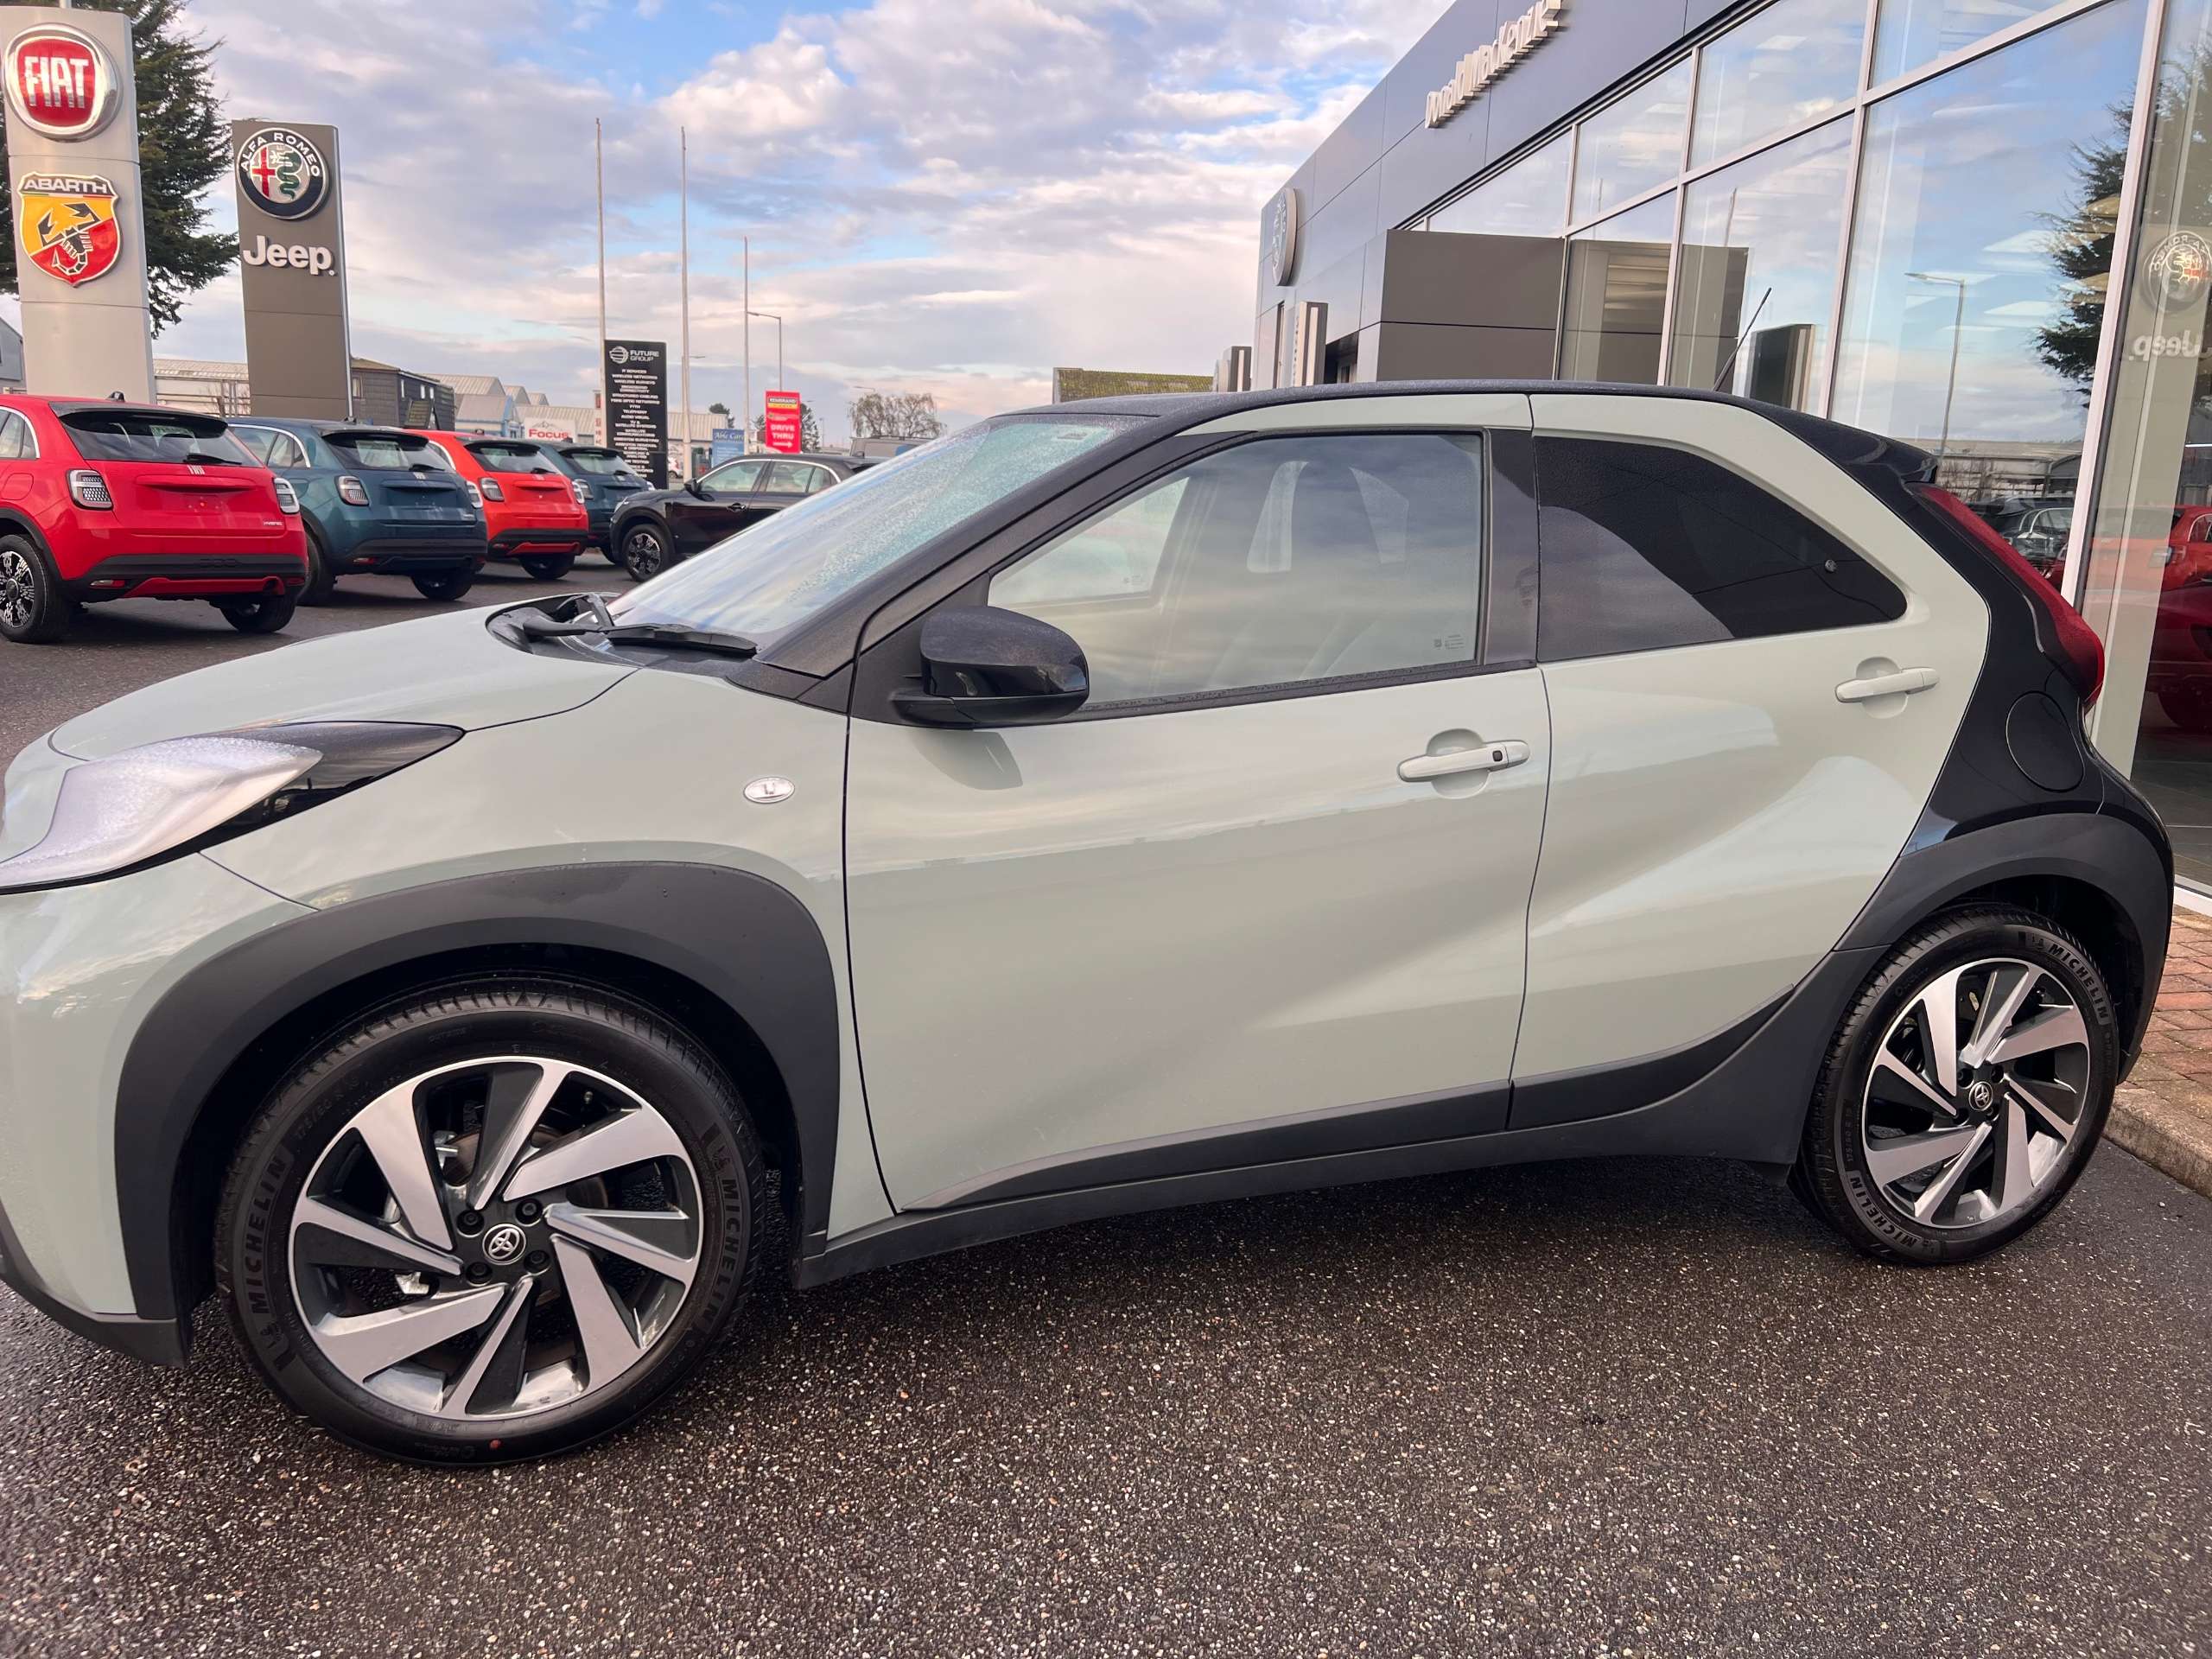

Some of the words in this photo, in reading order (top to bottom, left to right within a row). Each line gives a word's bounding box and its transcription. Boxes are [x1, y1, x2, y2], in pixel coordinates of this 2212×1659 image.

[24, 55, 90, 108] FIAT
[23, 177, 108, 194] ABARTH
[240, 136, 267, 171] ALFA
[273, 131, 321, 177] ROMEO
[770, 423, 795, 432] DRIVE
[2047, 943, 2109, 1019] MICHELIN
[245, 1158, 285, 1314] MICHELIN
[1850, 1176, 1919, 1249] MICHELIN
[702, 1179, 741, 1325] MICHELIN
